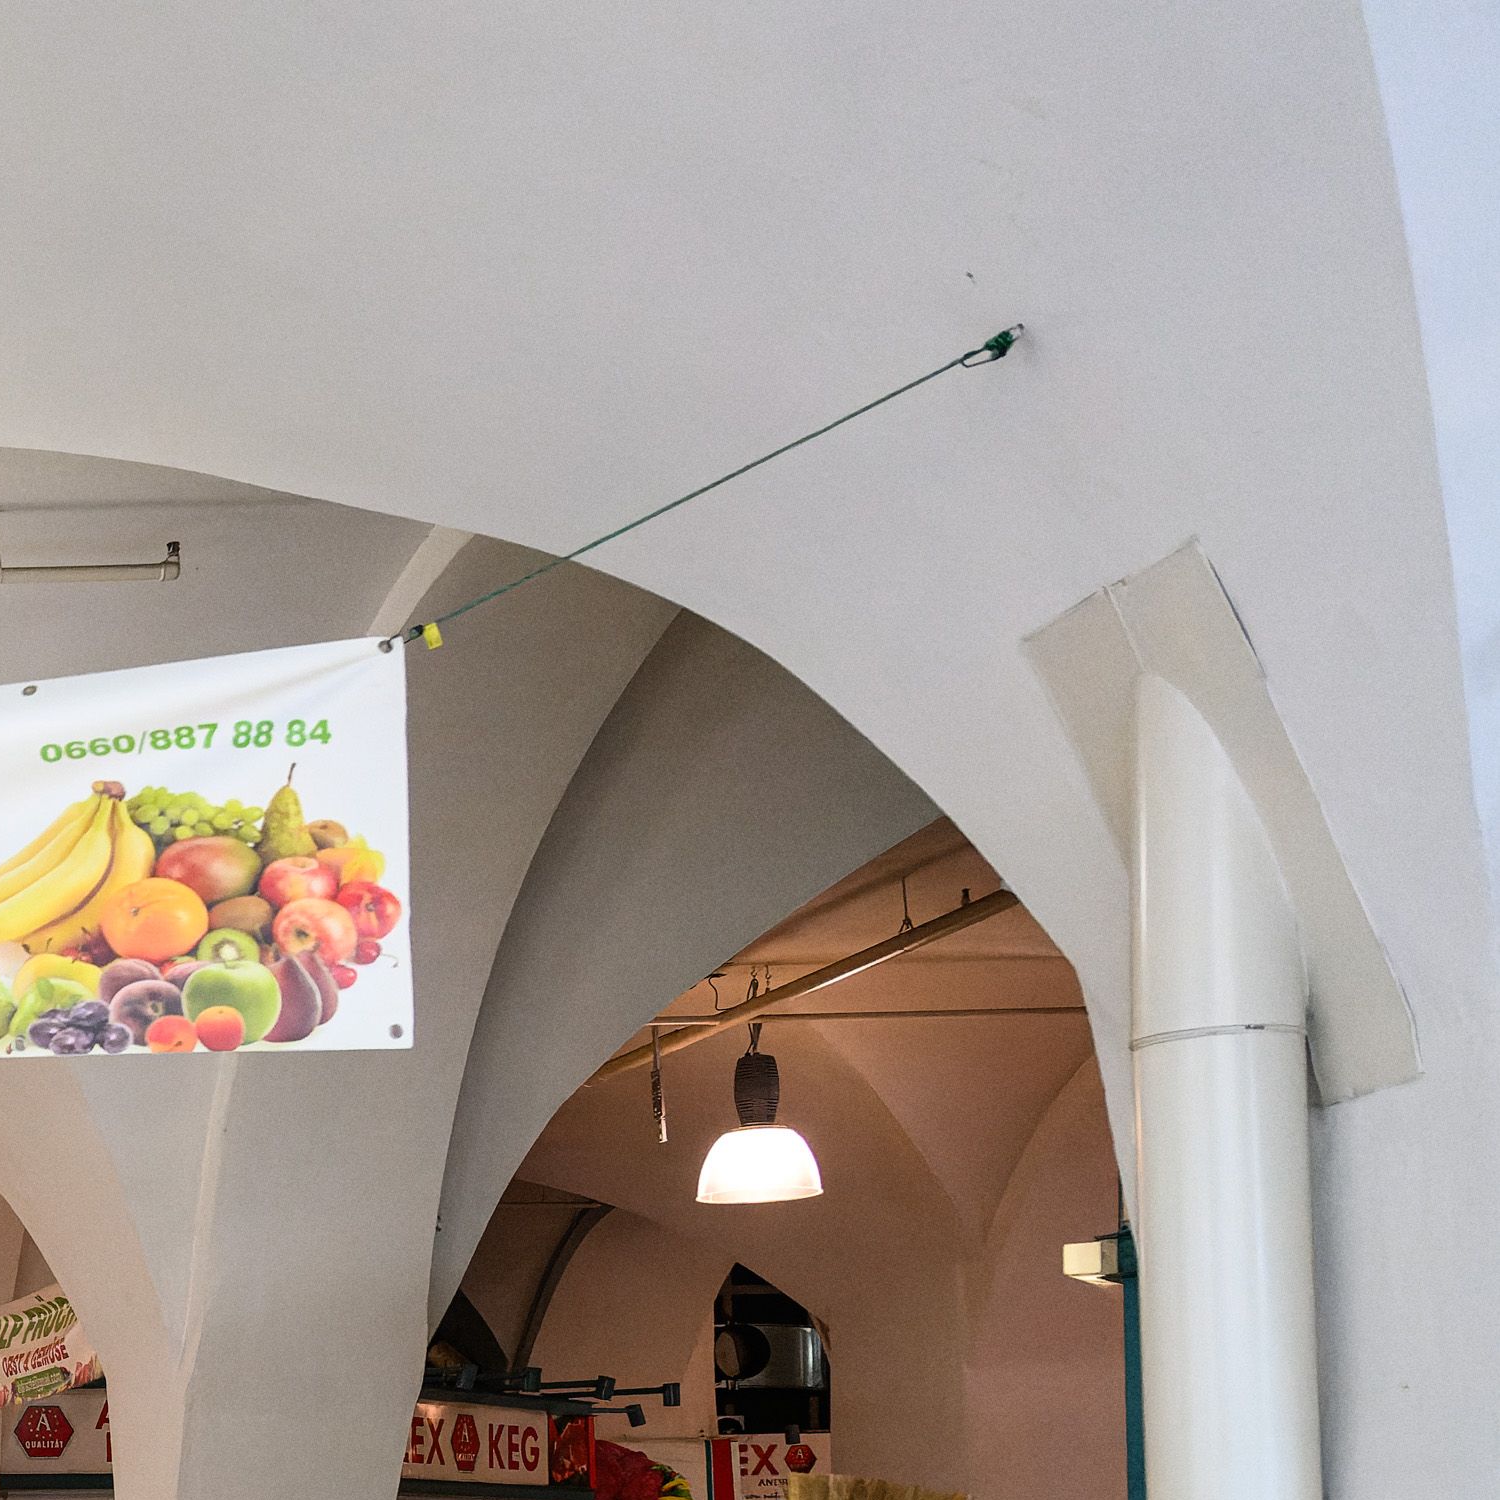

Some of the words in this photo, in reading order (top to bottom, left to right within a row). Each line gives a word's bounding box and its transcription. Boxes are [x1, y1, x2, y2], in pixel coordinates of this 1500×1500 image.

[39, 722, 218, 765] 0660/887
[231, 720, 275, 752] 88
[284, 717, 333, 749] 84
[1, 1353, 25, 1378] OBST
[30, 1337, 70, 1370] GEMÜSE
[36, 1413, 52, 1432] A
[25, 1440, 64, 1449] QUALITÄT
[403, 1416, 446, 1466] EX
[488, 1422, 541, 1472] KEG
